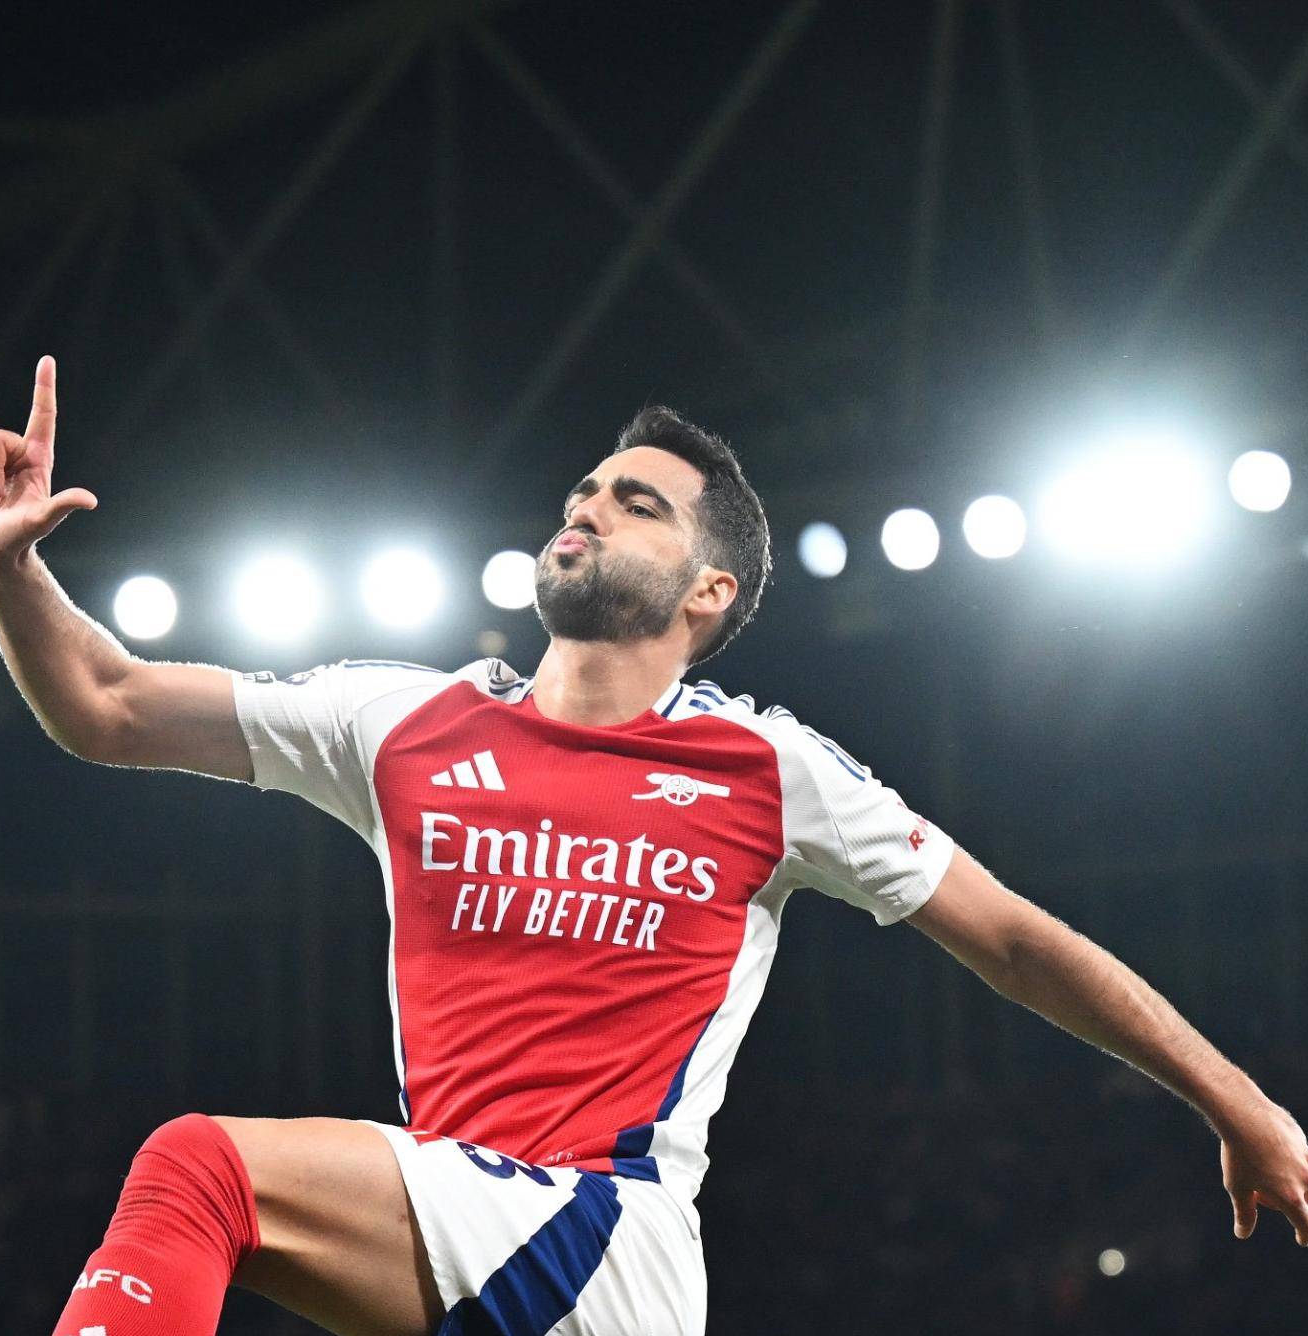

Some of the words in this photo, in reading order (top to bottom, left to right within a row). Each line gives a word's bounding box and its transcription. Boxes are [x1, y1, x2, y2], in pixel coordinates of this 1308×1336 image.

[420, 811, 719, 902] Emirates
[451, 883, 517, 933] FLY
[523, 887, 666, 951] BETTER
